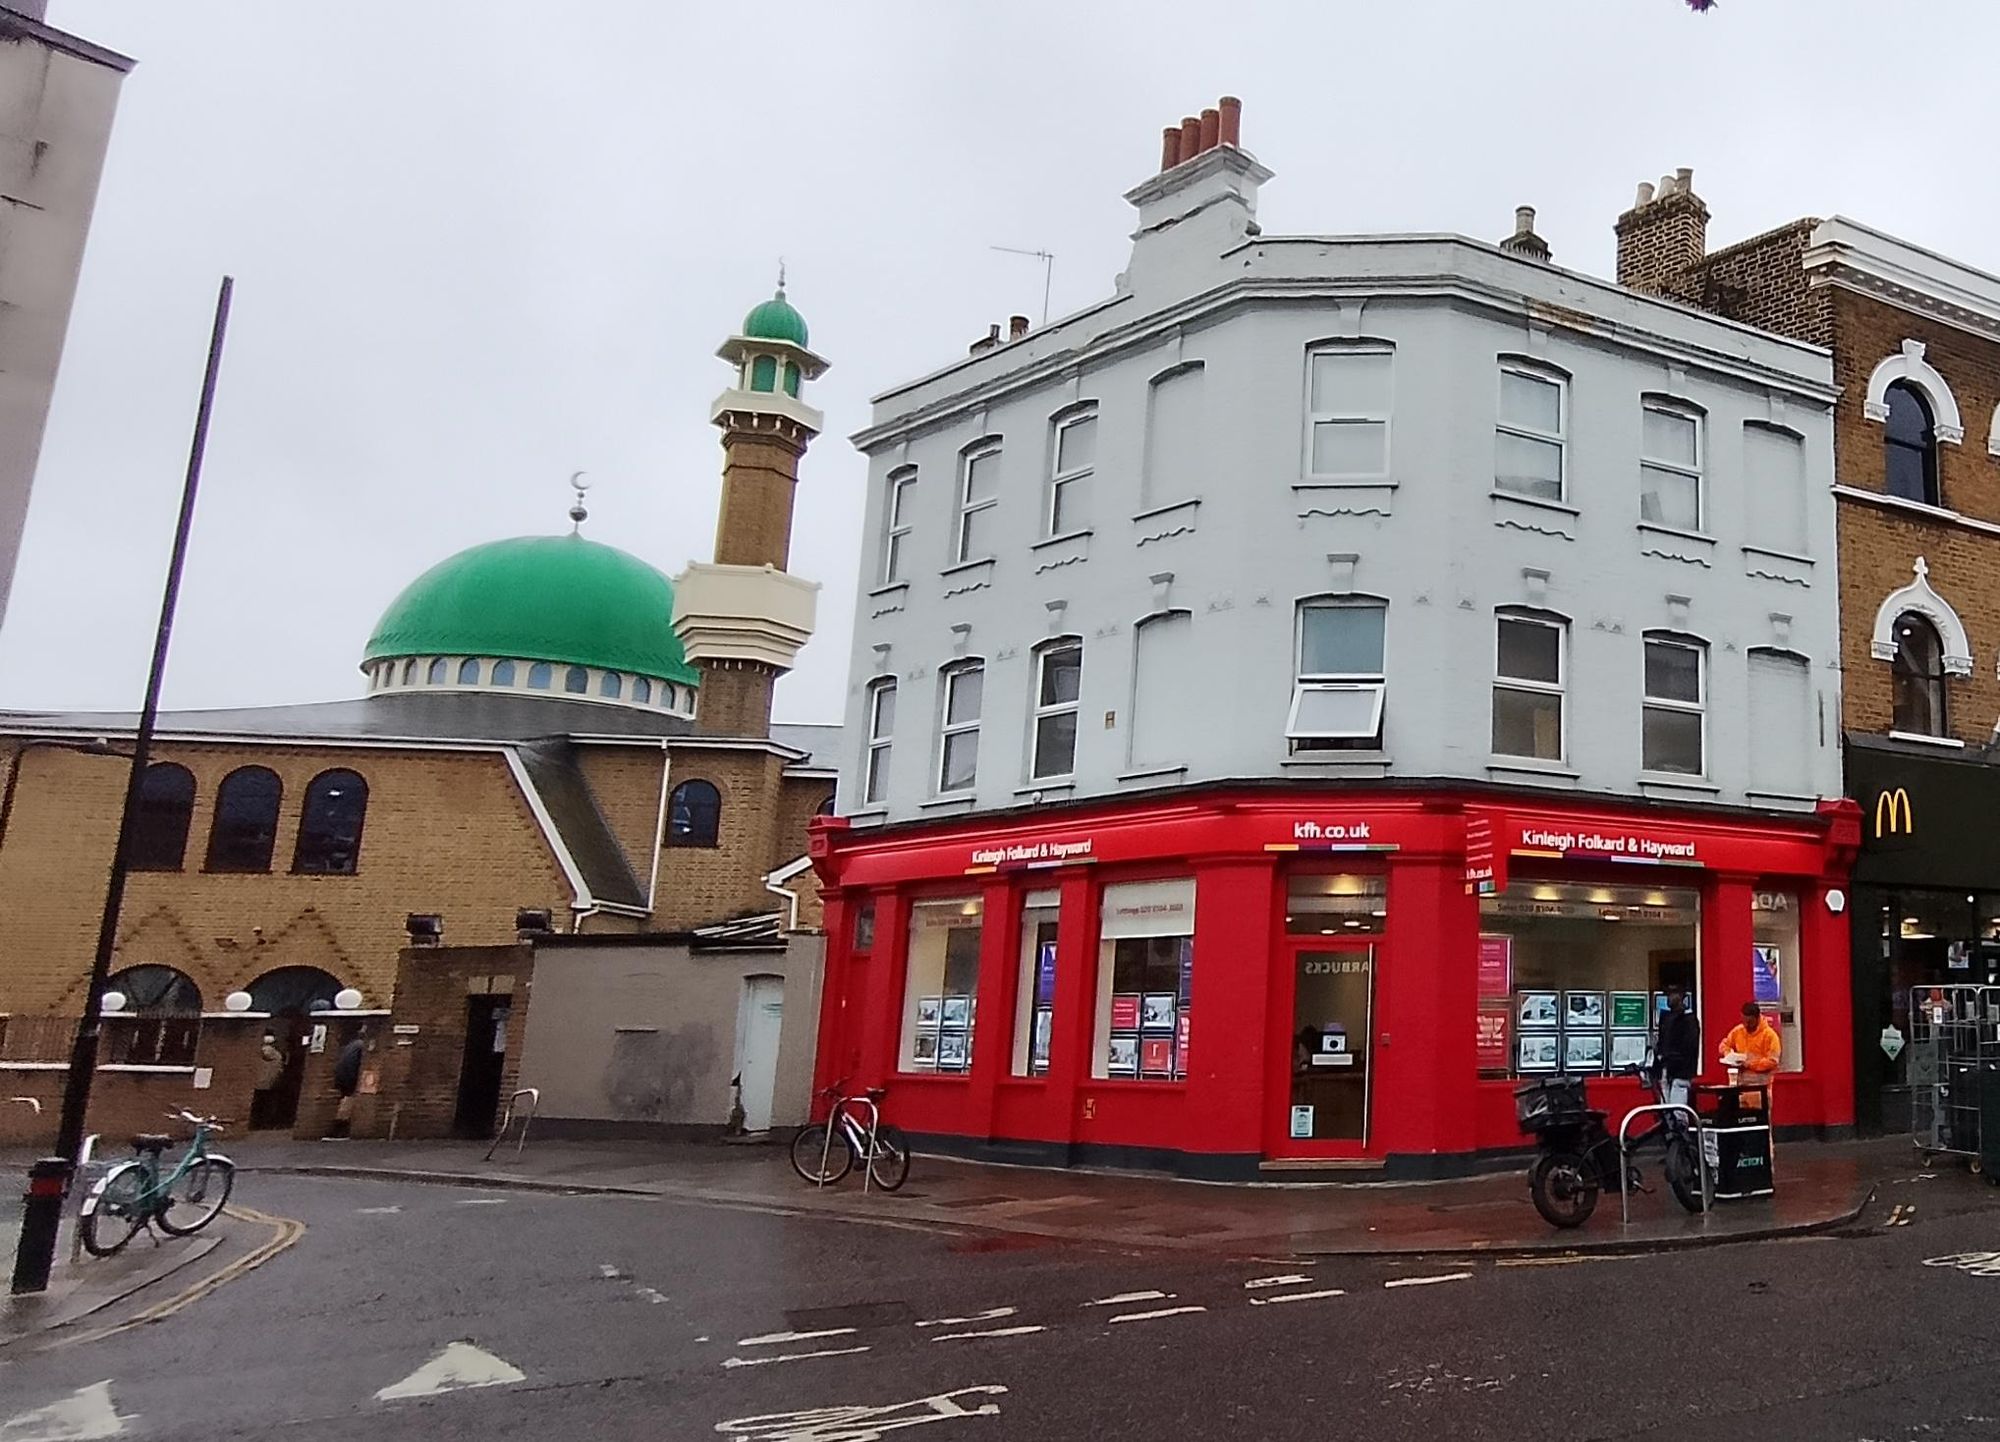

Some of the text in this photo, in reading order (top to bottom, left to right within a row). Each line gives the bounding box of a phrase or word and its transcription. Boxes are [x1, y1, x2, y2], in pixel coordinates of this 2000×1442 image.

[1876, 788, 1912, 838] M
[1294, 821, 1370, 838] kfh.co.uk
[972, 838, 1092, 866] Kinleigh Folkard & Hayward
[1522, 830, 1695, 858] Kinleigh Folkard & Hayward
[1736, 1156, 1764, 1168] ACTON
